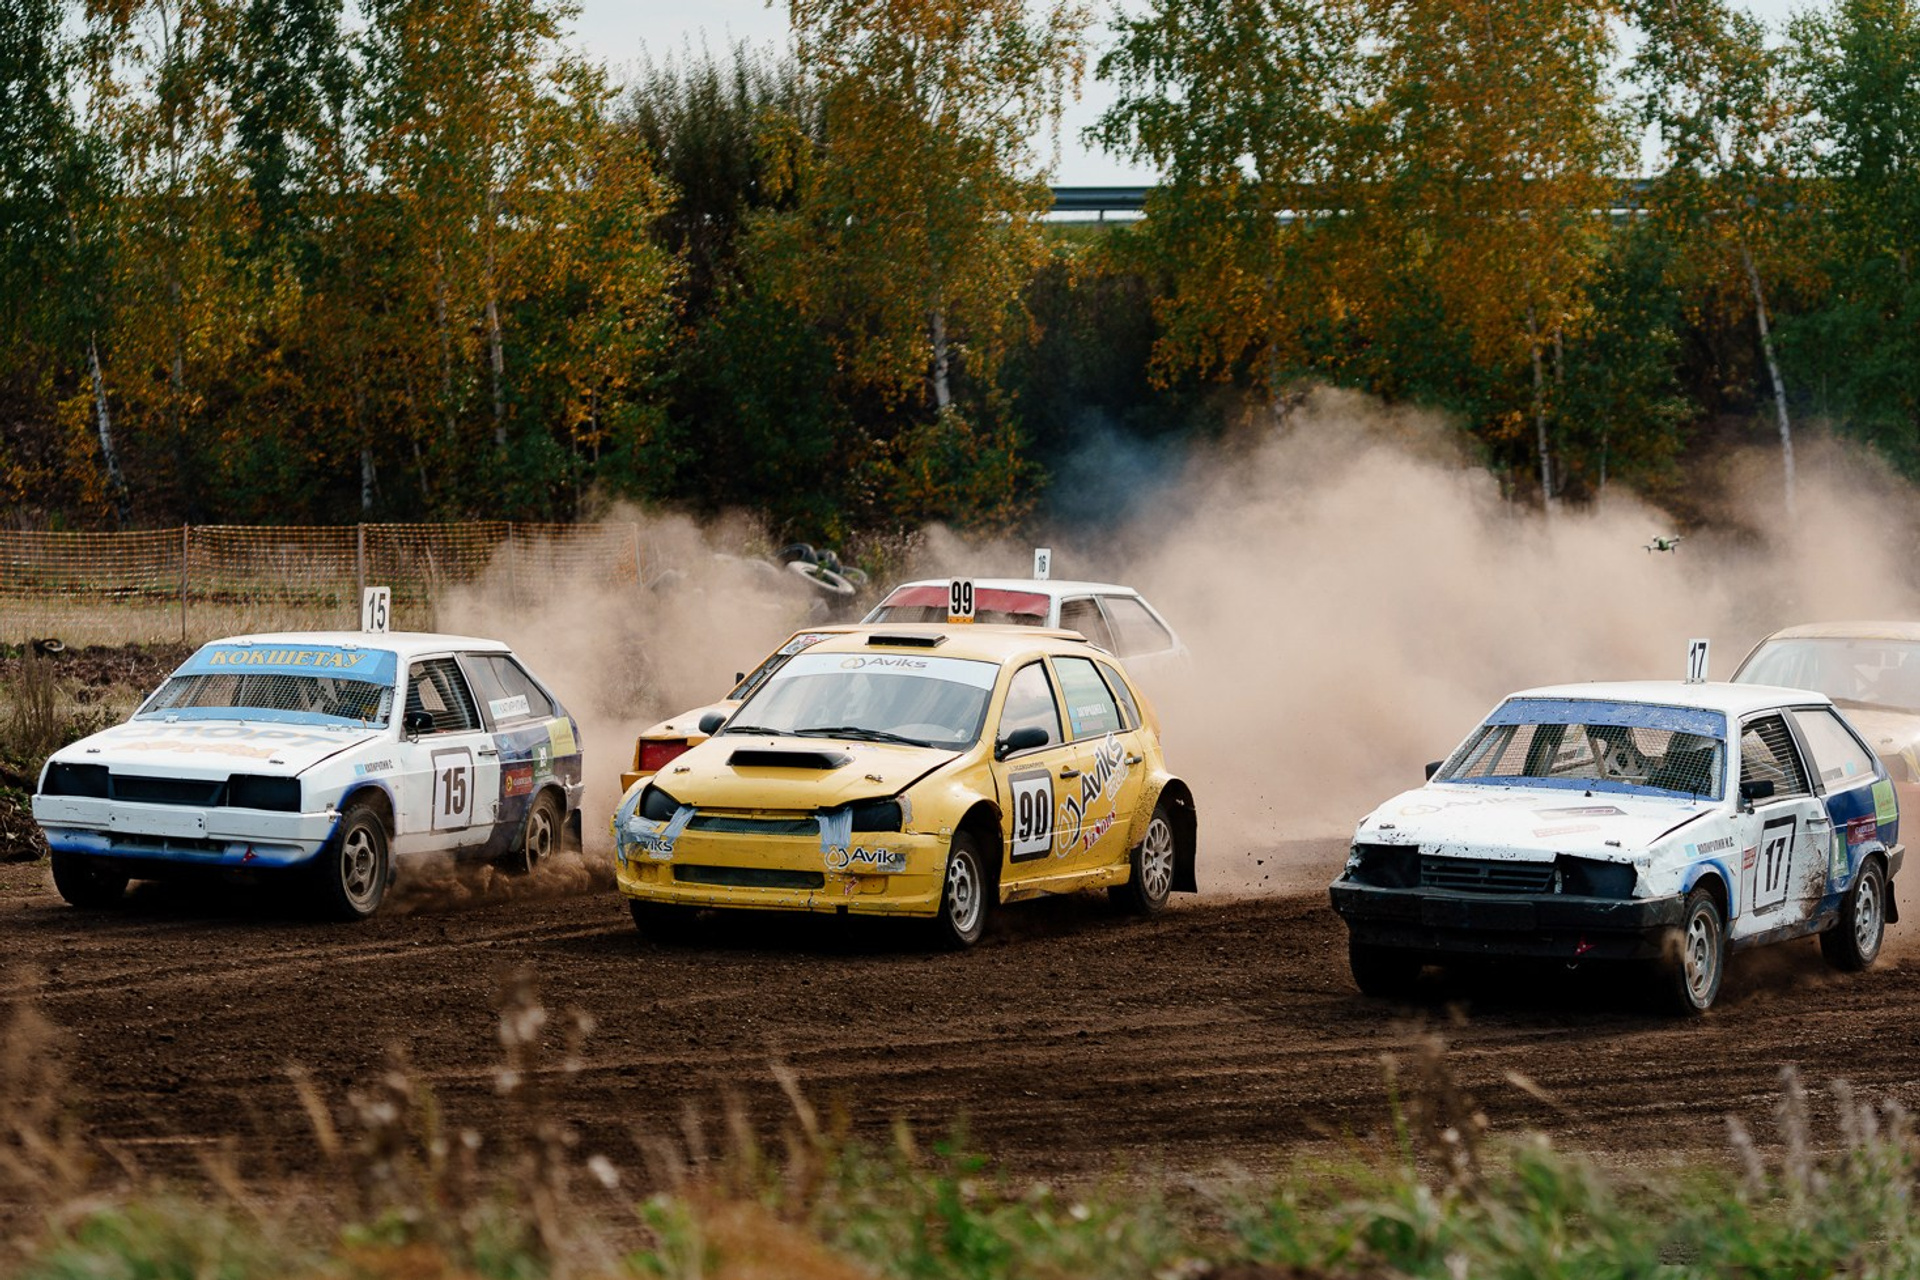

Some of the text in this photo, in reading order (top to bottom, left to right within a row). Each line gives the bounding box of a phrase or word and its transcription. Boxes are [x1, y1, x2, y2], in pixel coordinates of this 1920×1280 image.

[1038, 555, 1047, 573] 16
[368, 592, 386, 630] 15
[951, 581, 973, 615] 99
[208, 650, 367, 669] КОКШЕТАУ
[867, 657, 928, 668] Aviks
[1690, 642, 1707, 679] 17
[442, 767, 467, 815] 15
[1080, 731, 1124, 816] Aviks
[1019, 788, 1049, 842] 90
[1765, 837, 1787, 892] 17
